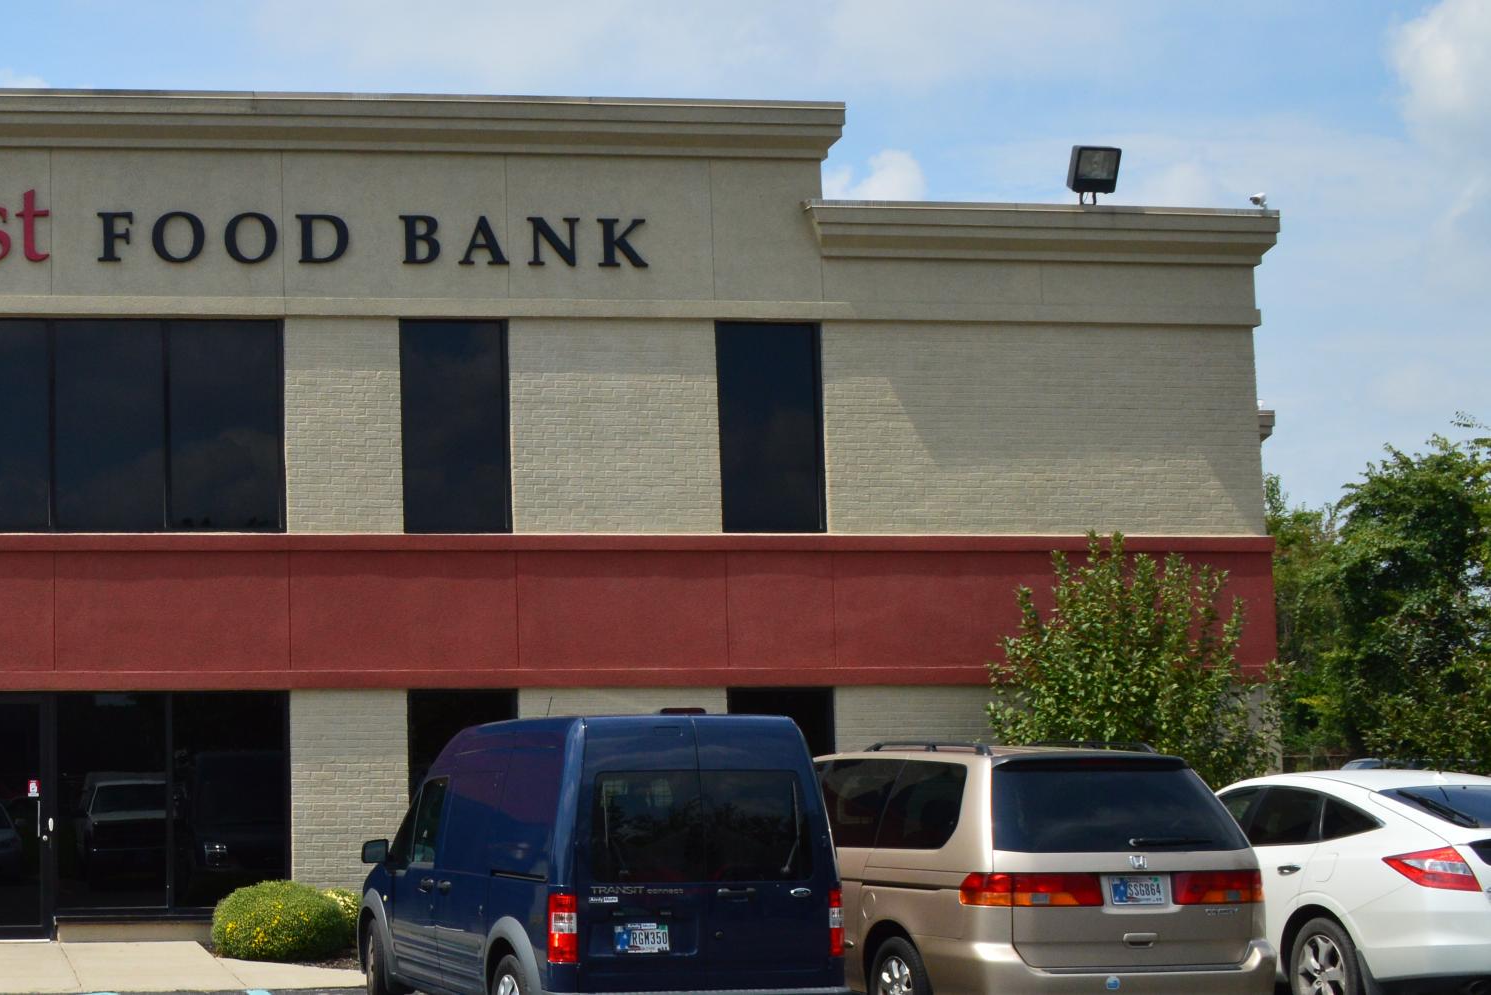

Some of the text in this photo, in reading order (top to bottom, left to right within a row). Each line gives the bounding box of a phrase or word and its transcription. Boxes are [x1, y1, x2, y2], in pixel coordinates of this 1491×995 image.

[97, 211, 350, 264] FOOD
[398, 214, 649, 268] BANK
[590, 886, 644, 895] TRANSIT
[1128, 883, 1162, 897] SSG864
